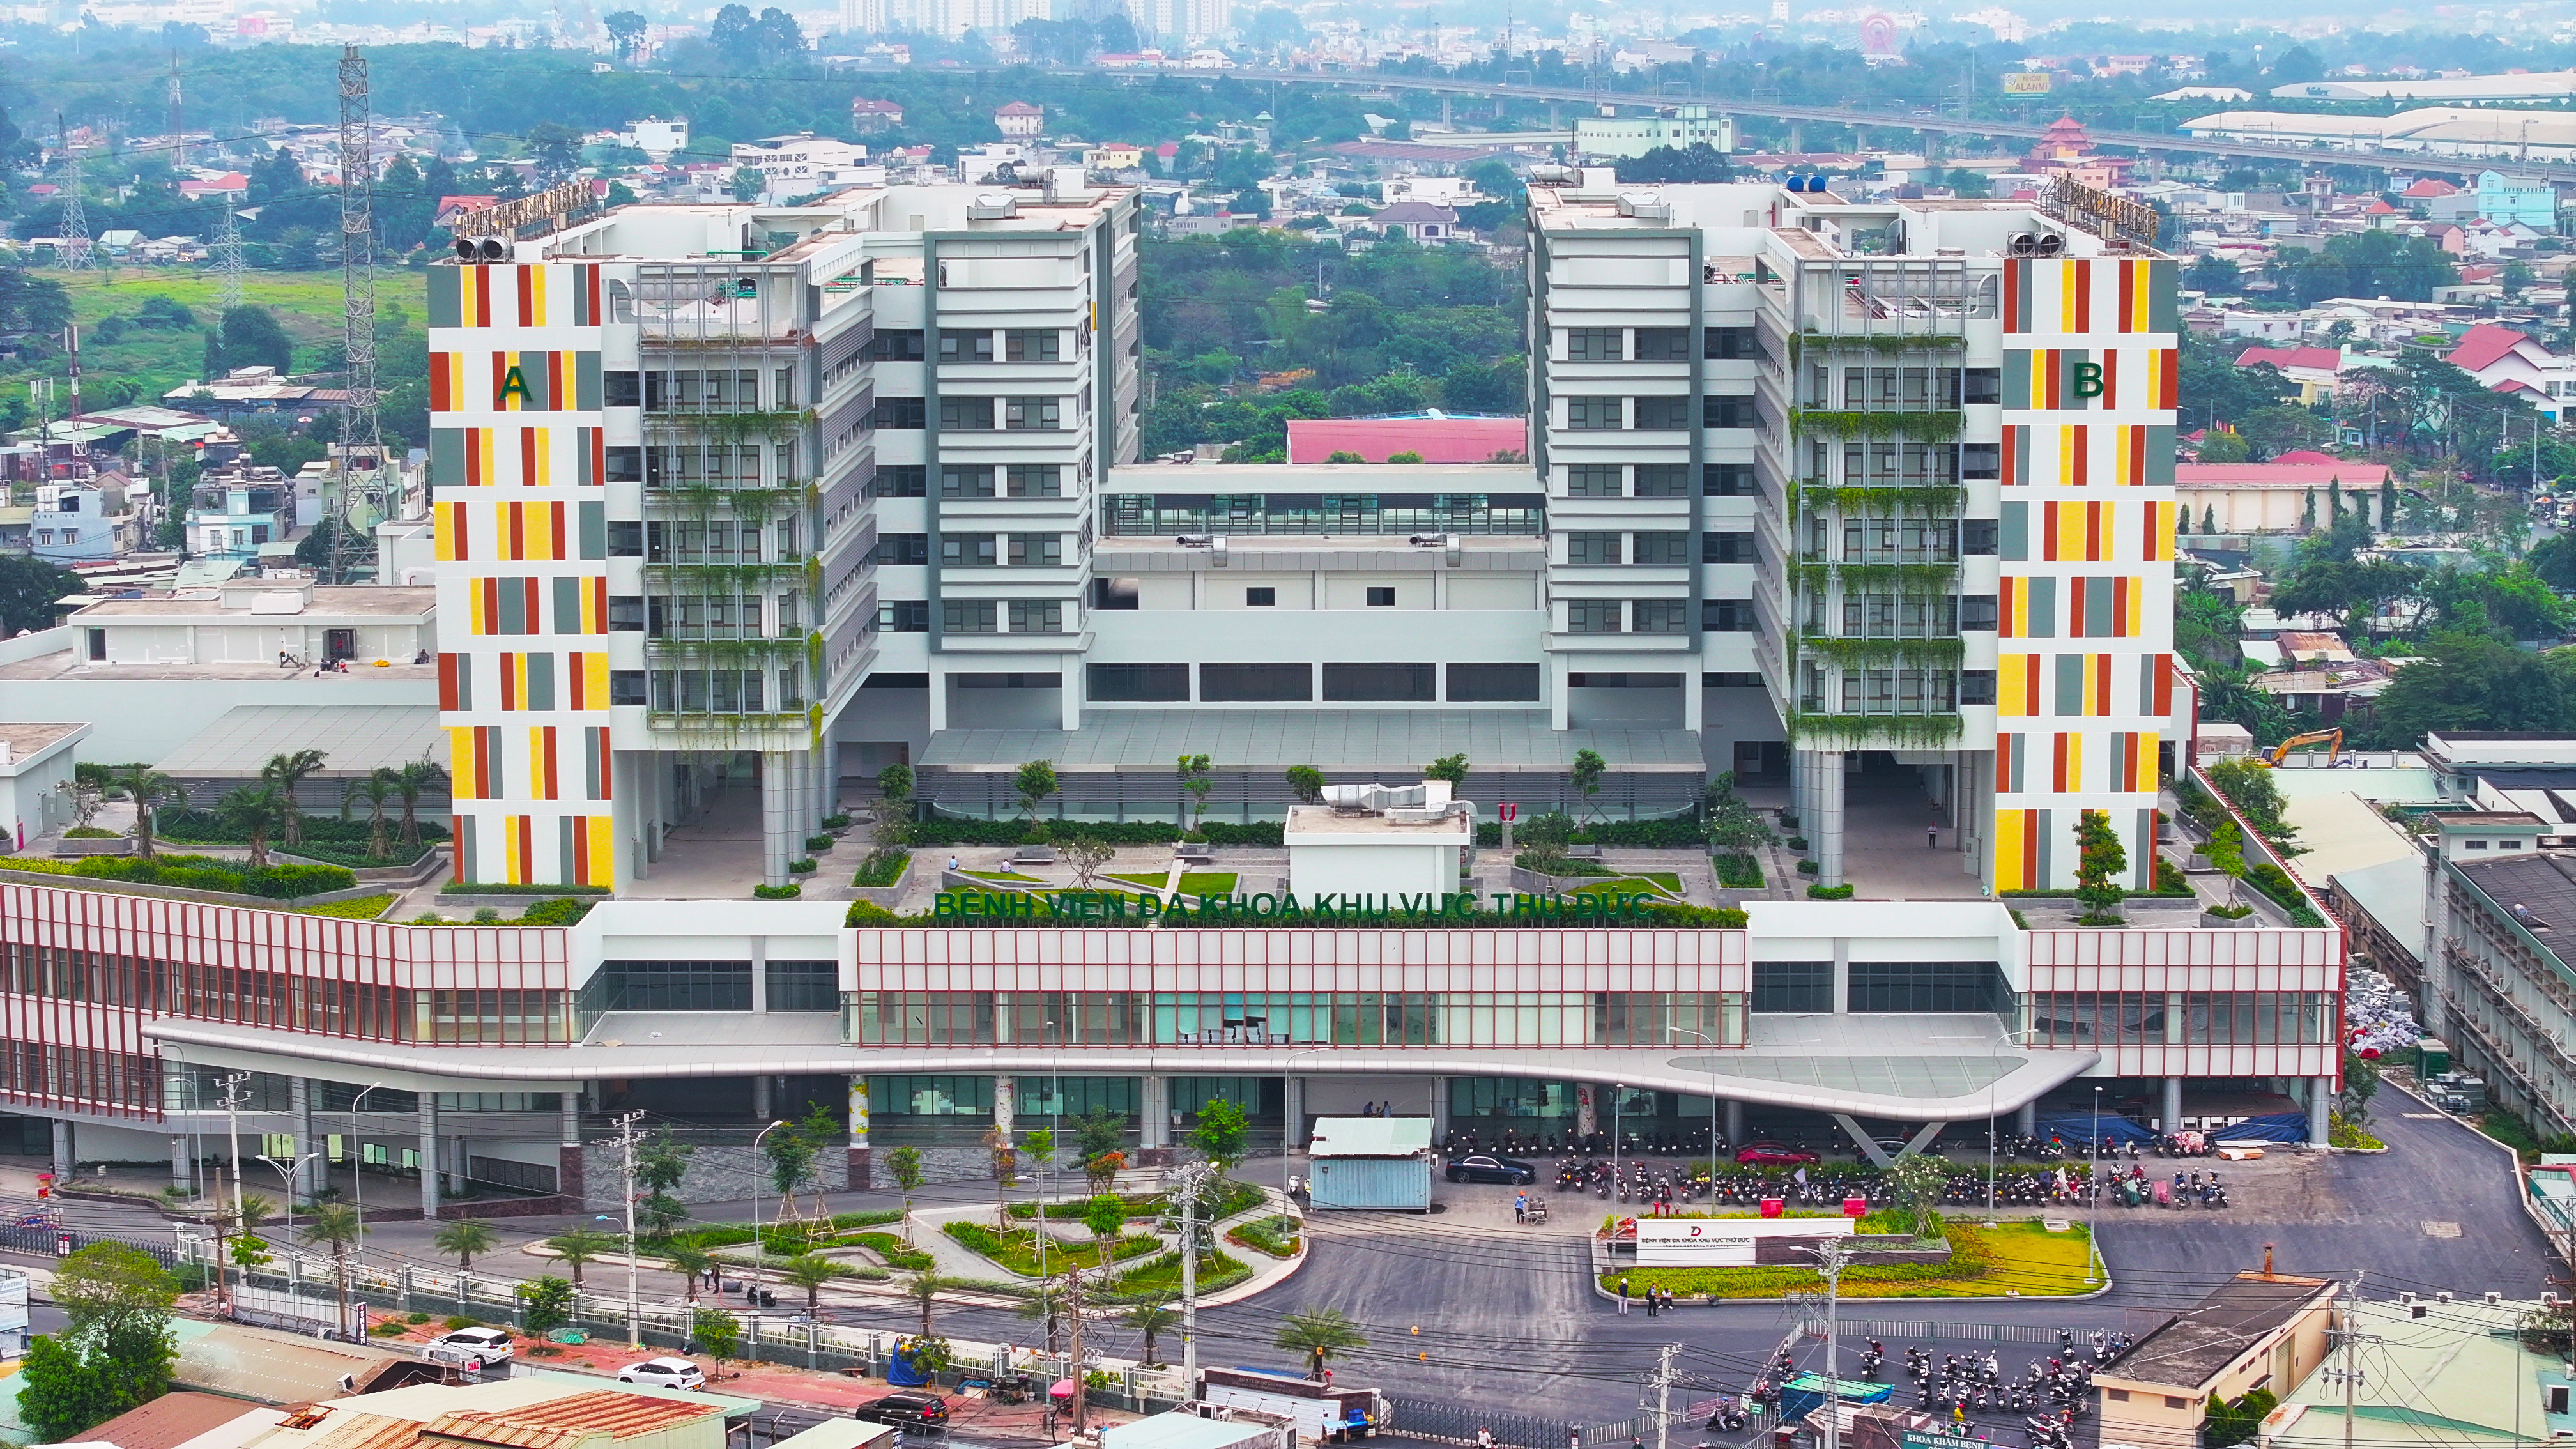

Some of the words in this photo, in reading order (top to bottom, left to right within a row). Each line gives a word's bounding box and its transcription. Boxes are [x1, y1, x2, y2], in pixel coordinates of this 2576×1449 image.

[498, 365, 533, 401] A
[2074, 362, 2104, 398] B
[933, 887, 1032, 924] BỆNH
[1043, 887, 1126, 924] VIỆN
[1137, 892, 1190, 919] ĐA
[1199, 892, 1304, 919] KHOA
[1314, 892, 1388, 919] KHU
[1399, 892, 1479, 924] VỰC
[1490, 885, 1562, 919] THỦ
[1574, 885, 1655, 919] ĐỨC
[1906, 1434, 1931, 1444] KHOA
[1933, 1437, 1958, 1447] KHÁM
